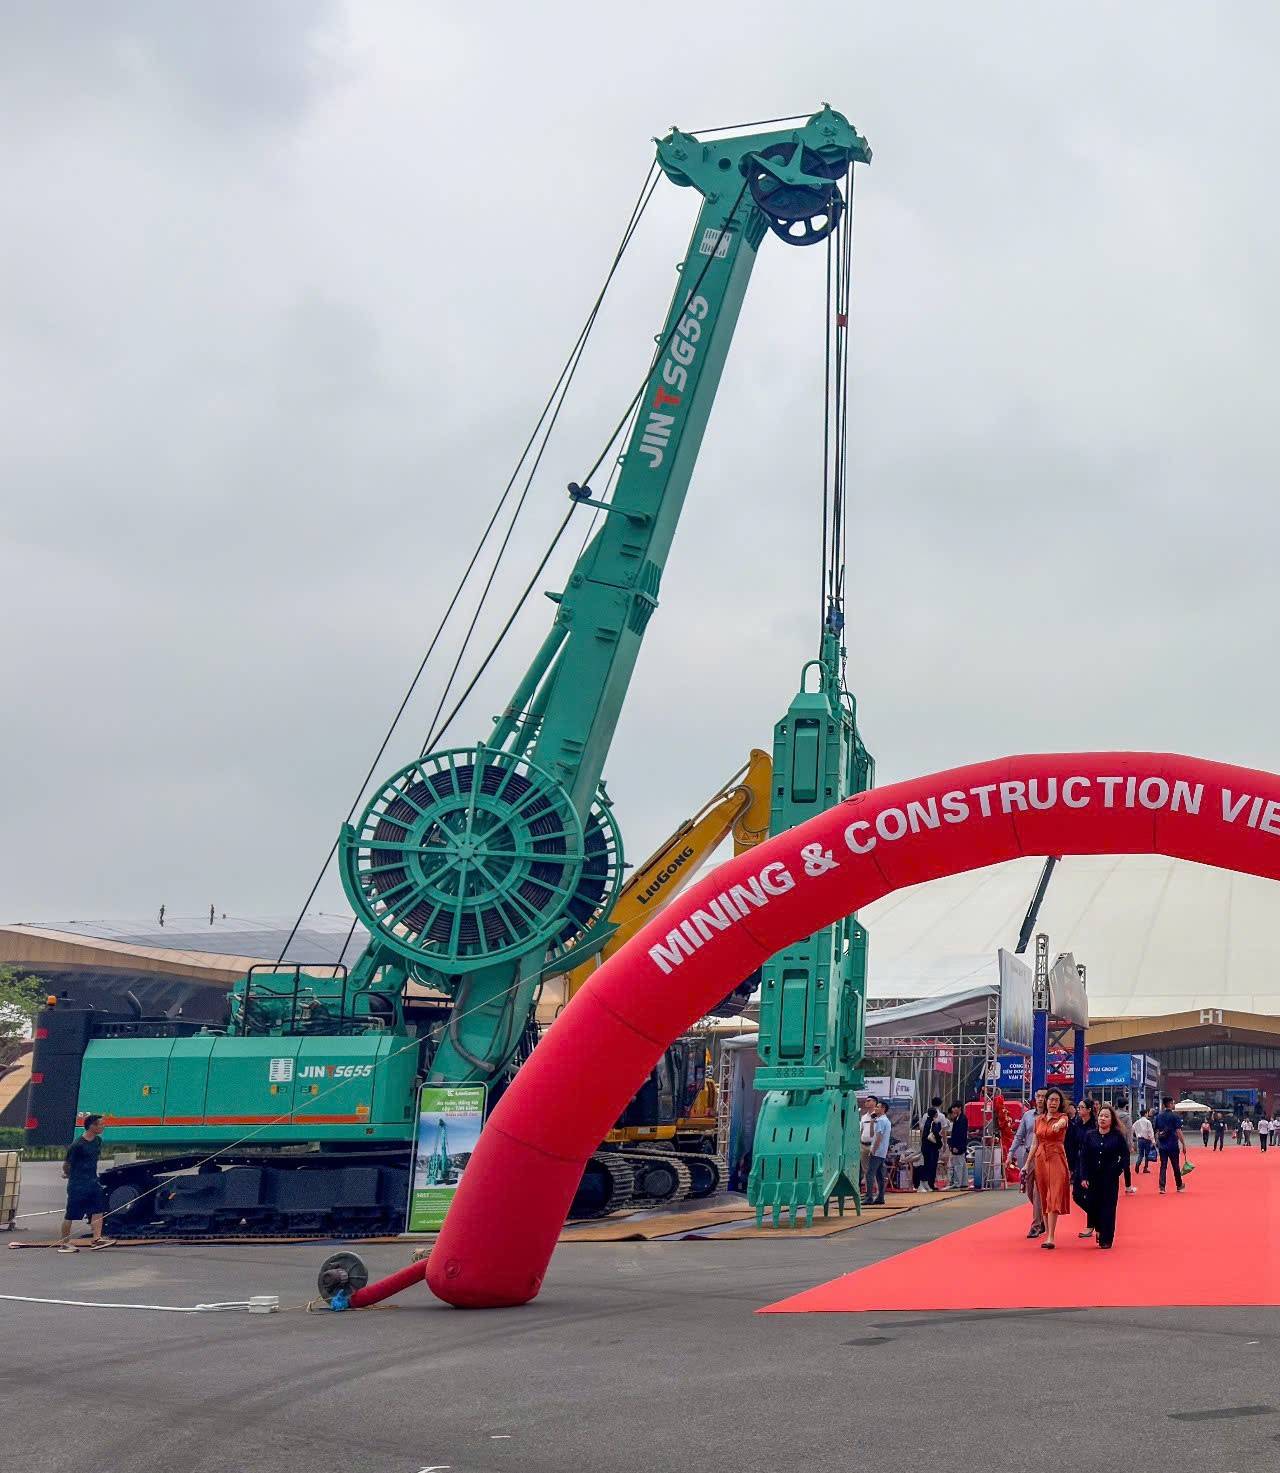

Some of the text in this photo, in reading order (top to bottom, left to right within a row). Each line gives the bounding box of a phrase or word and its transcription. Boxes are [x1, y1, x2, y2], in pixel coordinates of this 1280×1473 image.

[663, 289, 709, 393] SG55
[648, 861, 797, 975] MINING
[800, 842, 840, 877] &
[844, 776, 1204, 855] CONSTRUCTION
[1200, 1009, 1223, 1024] H1
